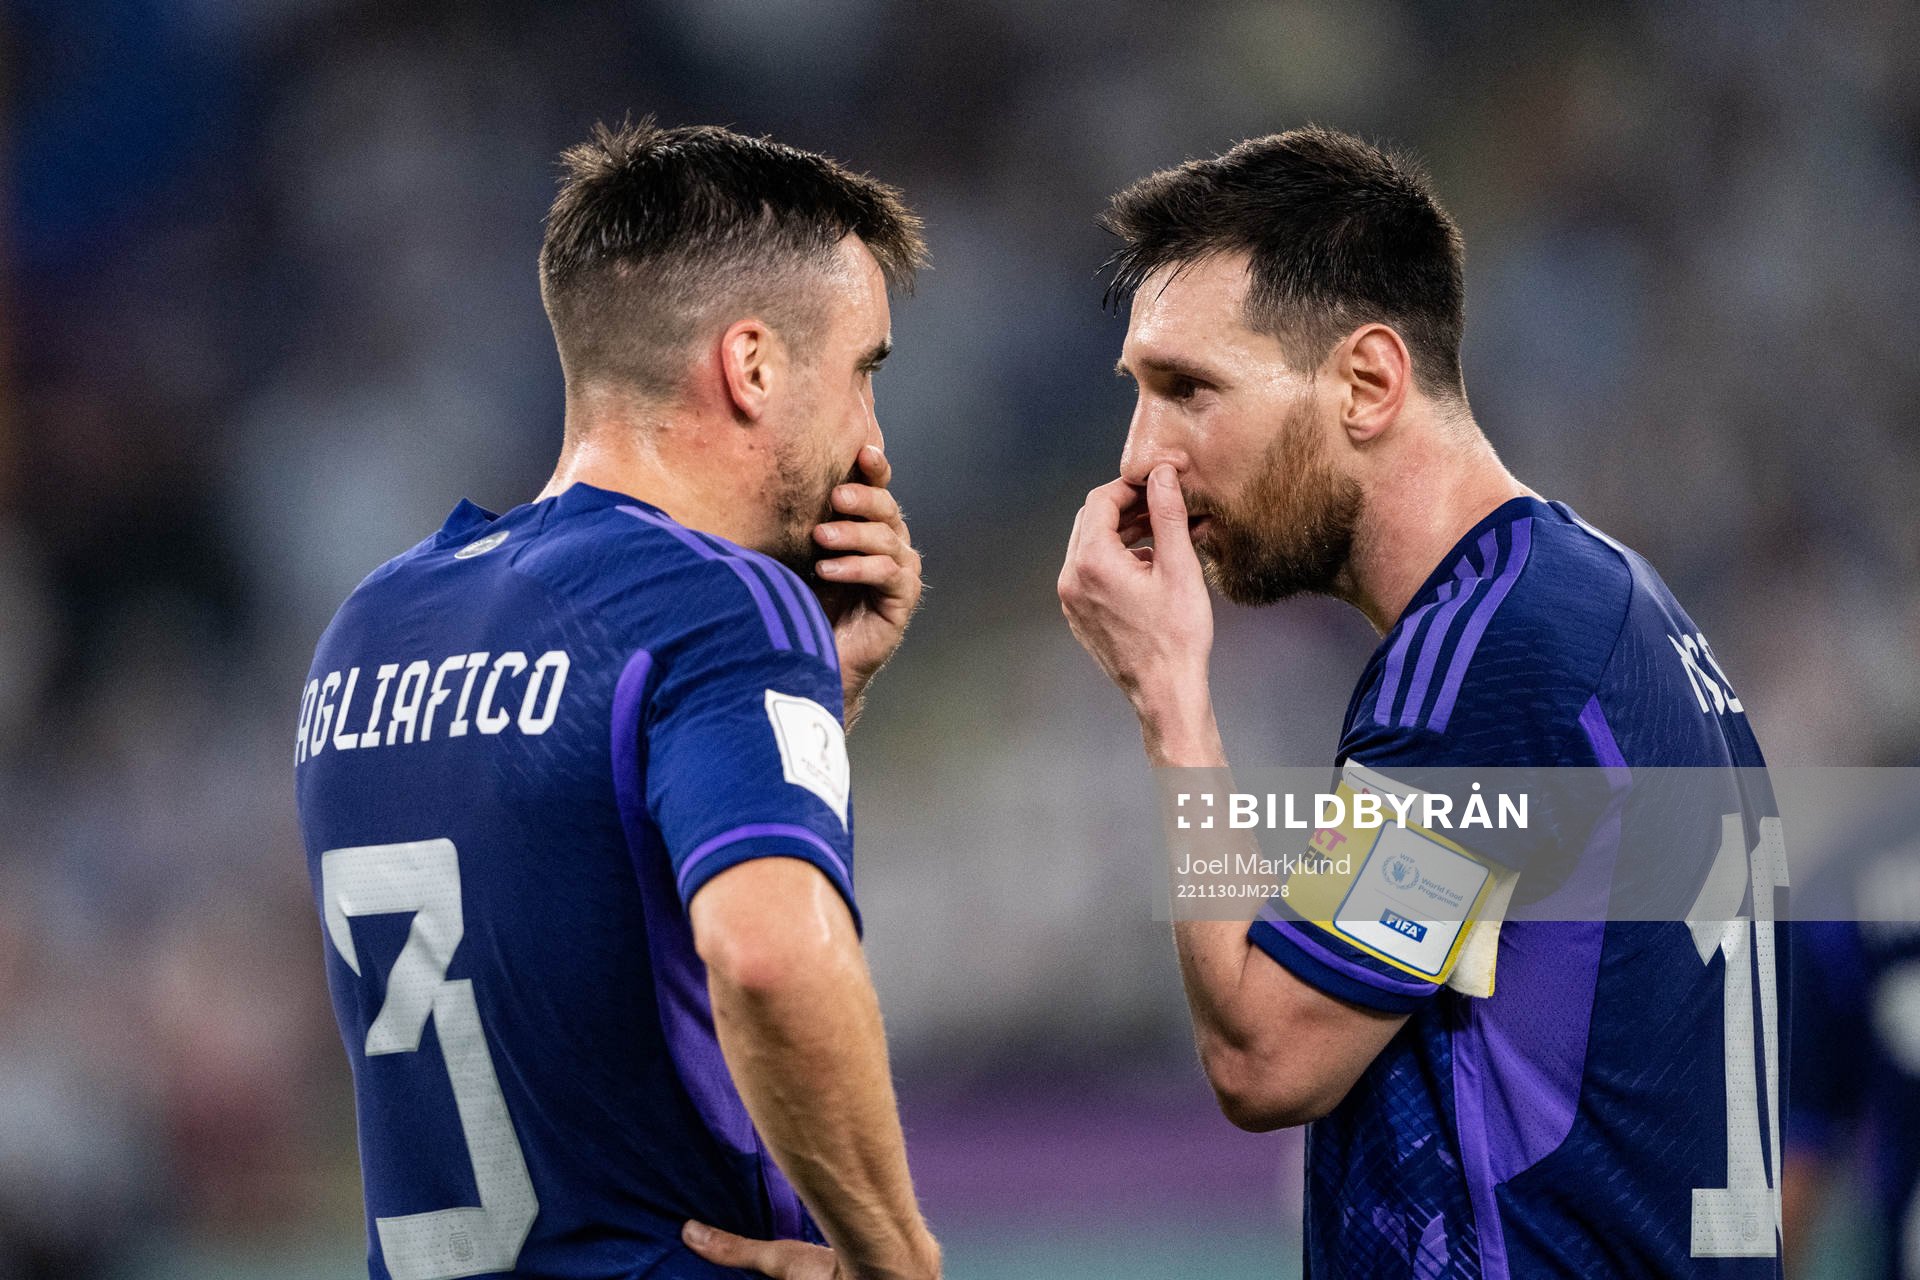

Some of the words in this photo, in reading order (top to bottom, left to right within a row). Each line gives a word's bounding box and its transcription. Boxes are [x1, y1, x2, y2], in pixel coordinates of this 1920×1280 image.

[295, 650, 571, 767] AGLIAFICO
[1417, 885, 1459, 908] Programme
[1421, 877, 1445, 893] World
[1445, 889, 1463, 902] Food
[1386, 914, 1418, 938] FIFA
[321, 837, 540, 1280] 3
